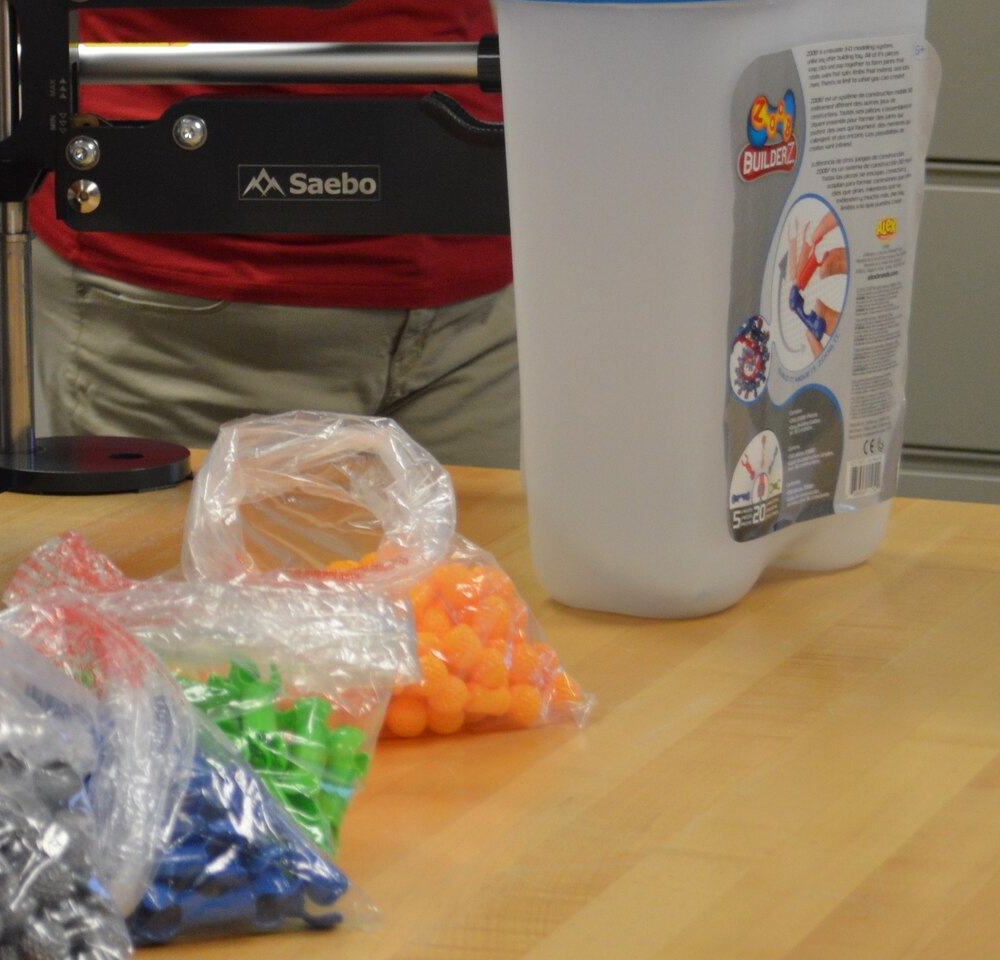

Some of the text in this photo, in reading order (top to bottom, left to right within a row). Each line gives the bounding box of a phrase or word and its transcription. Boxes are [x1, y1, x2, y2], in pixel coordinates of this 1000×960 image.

[743, 142, 795, 174] BUILDERZ
[290, 172, 376, 195] Saebo
[732, 510, 741, 529] 5
[752, 503, 766, 524] 20
